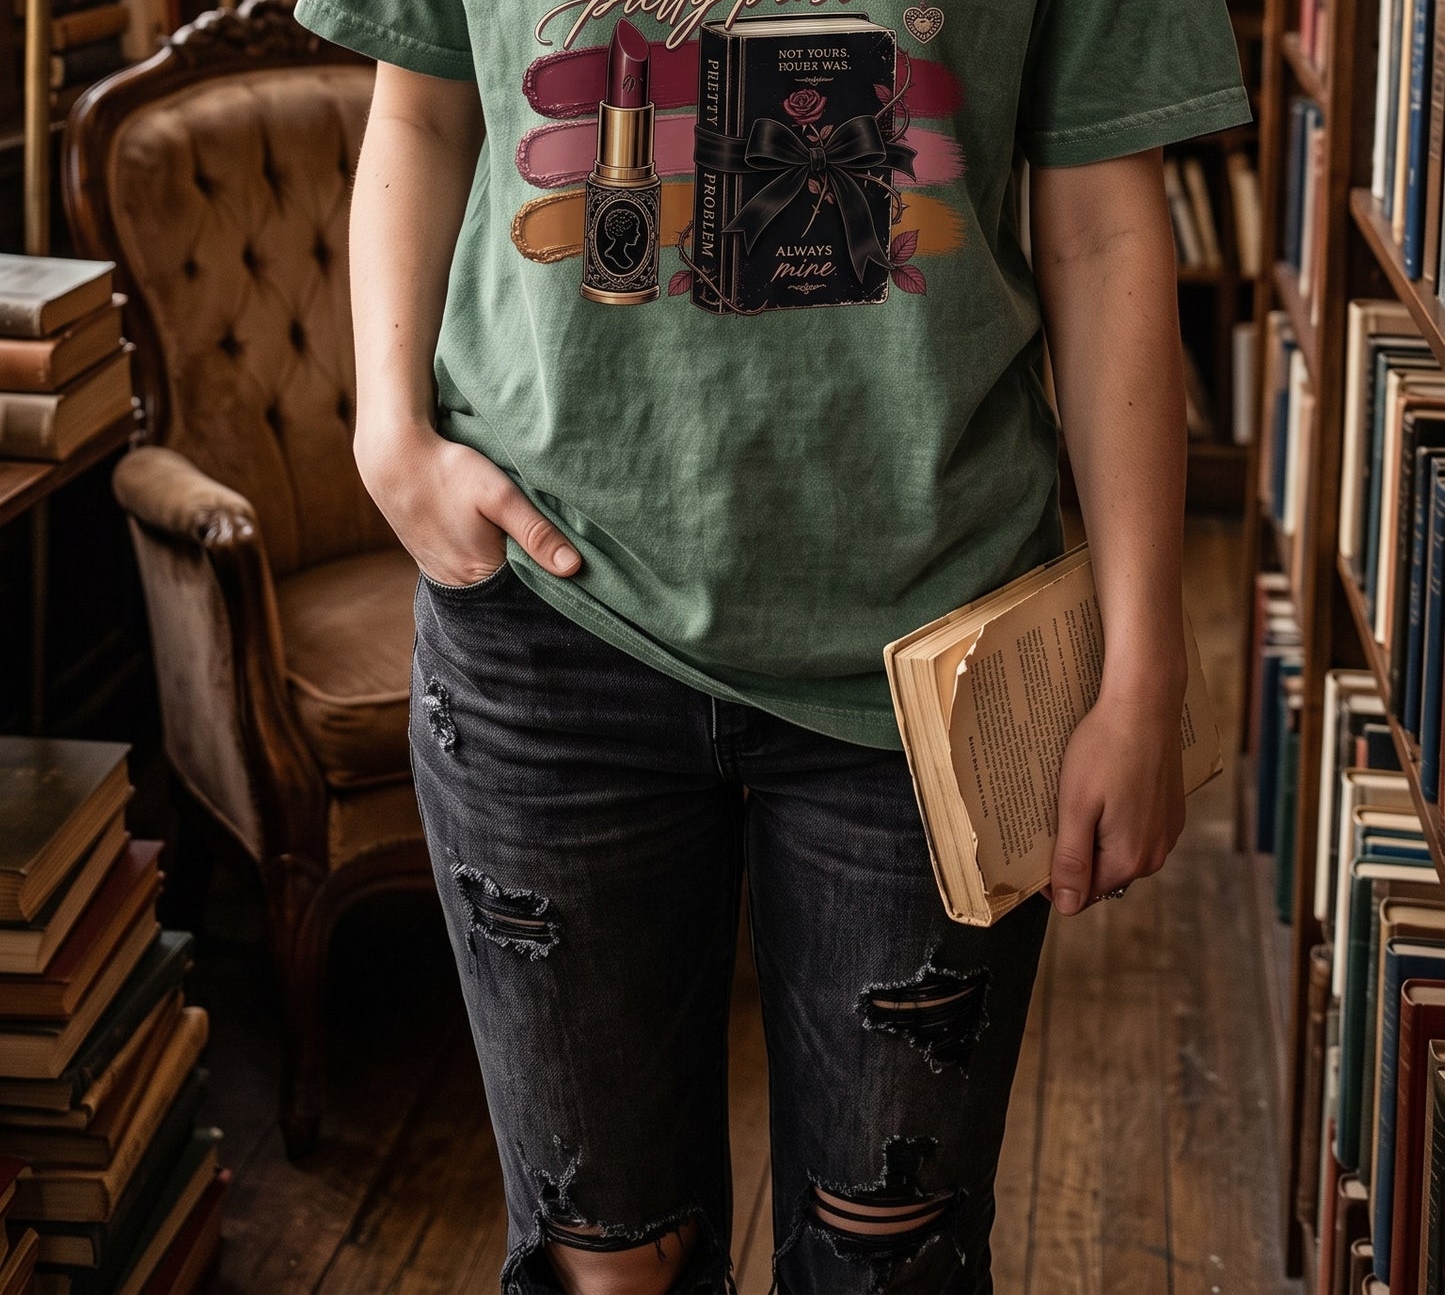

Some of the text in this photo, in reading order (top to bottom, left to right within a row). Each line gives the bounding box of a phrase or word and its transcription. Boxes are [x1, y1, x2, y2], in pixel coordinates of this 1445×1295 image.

[778, 48, 851, 59] NOT YOURS.
[822, 60, 852, 71] WAS.
[701, 59, 720, 258] PRETTY PROBLEM
[775, 245, 833, 257] ALWAYS
